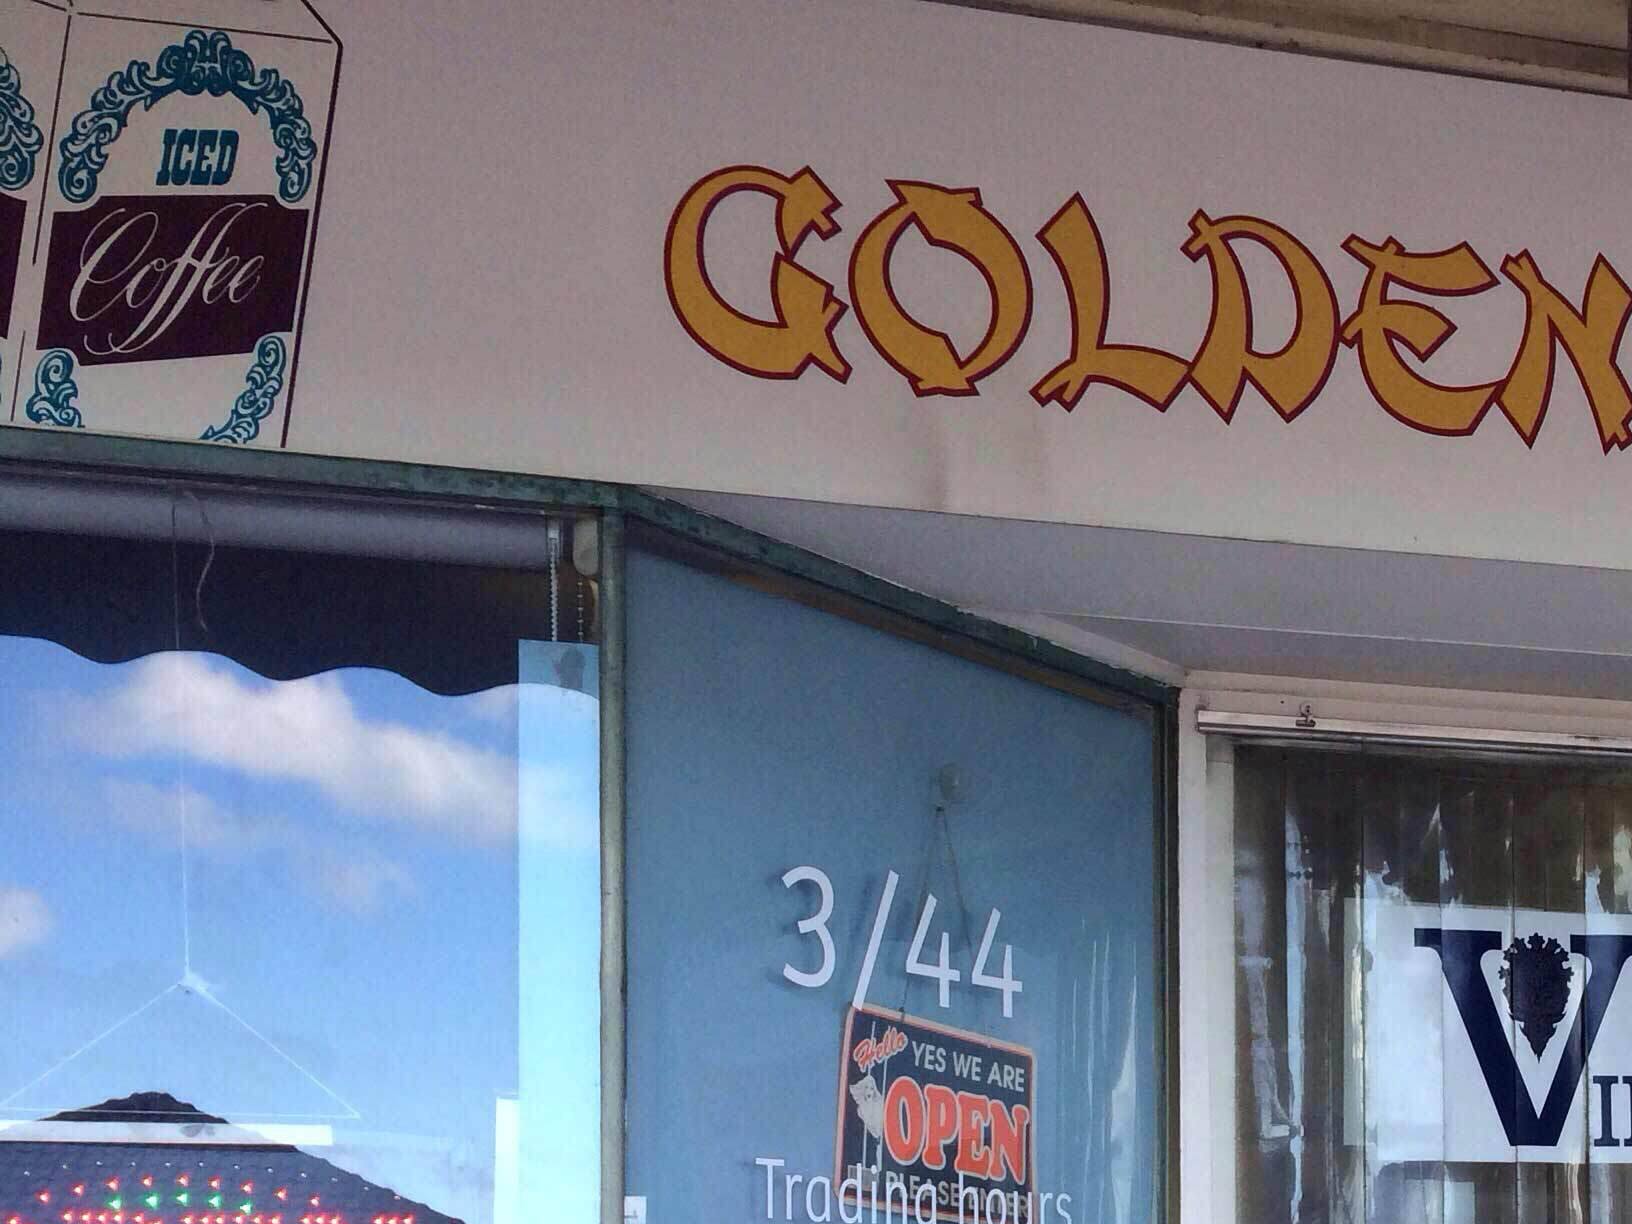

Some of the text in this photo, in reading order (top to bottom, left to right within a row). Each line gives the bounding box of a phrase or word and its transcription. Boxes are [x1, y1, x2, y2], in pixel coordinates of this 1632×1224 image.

[156, 128, 239, 186] ICED
[69, 201, 268, 355] Coffee
[782, 866, 1023, 1018] 3/44
[853, 1026, 908, 1073] Hello
[912, 1041, 1026, 1092] YES WE ARE
[884, 1075, 1030, 1185] OPEN
